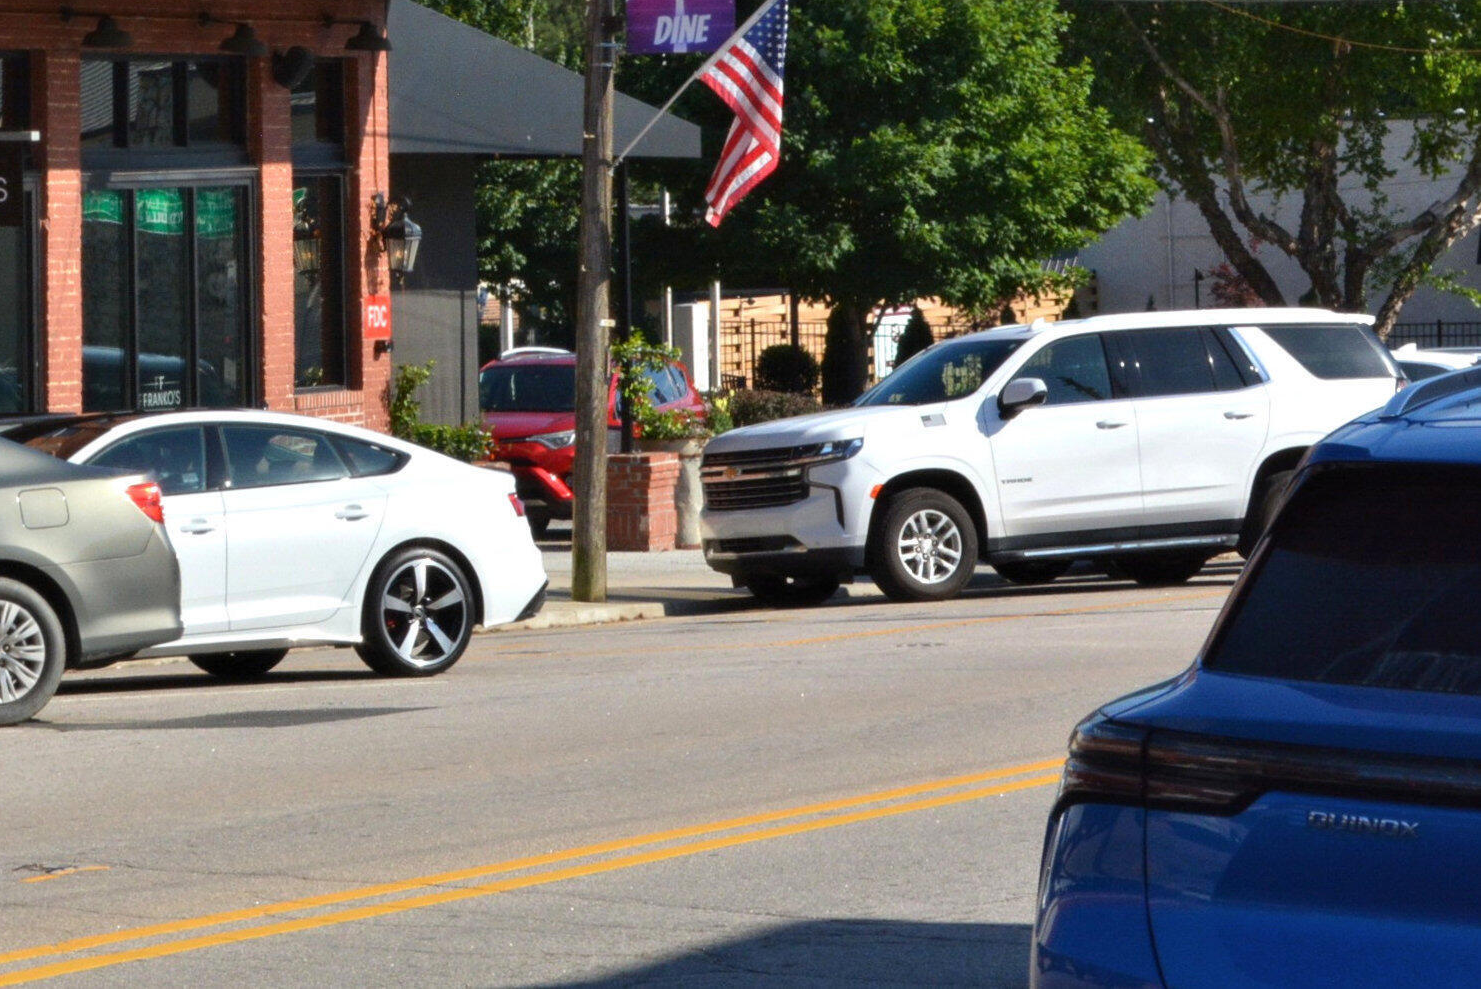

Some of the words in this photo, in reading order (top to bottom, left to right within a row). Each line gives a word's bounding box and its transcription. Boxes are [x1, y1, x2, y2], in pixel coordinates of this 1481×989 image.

[653, 14, 711, 46] DINE
[367, 304, 388, 328] FDC
[143, 390, 181, 408] FRANKO'S
[1290, 810, 1419, 834] QUINOX
